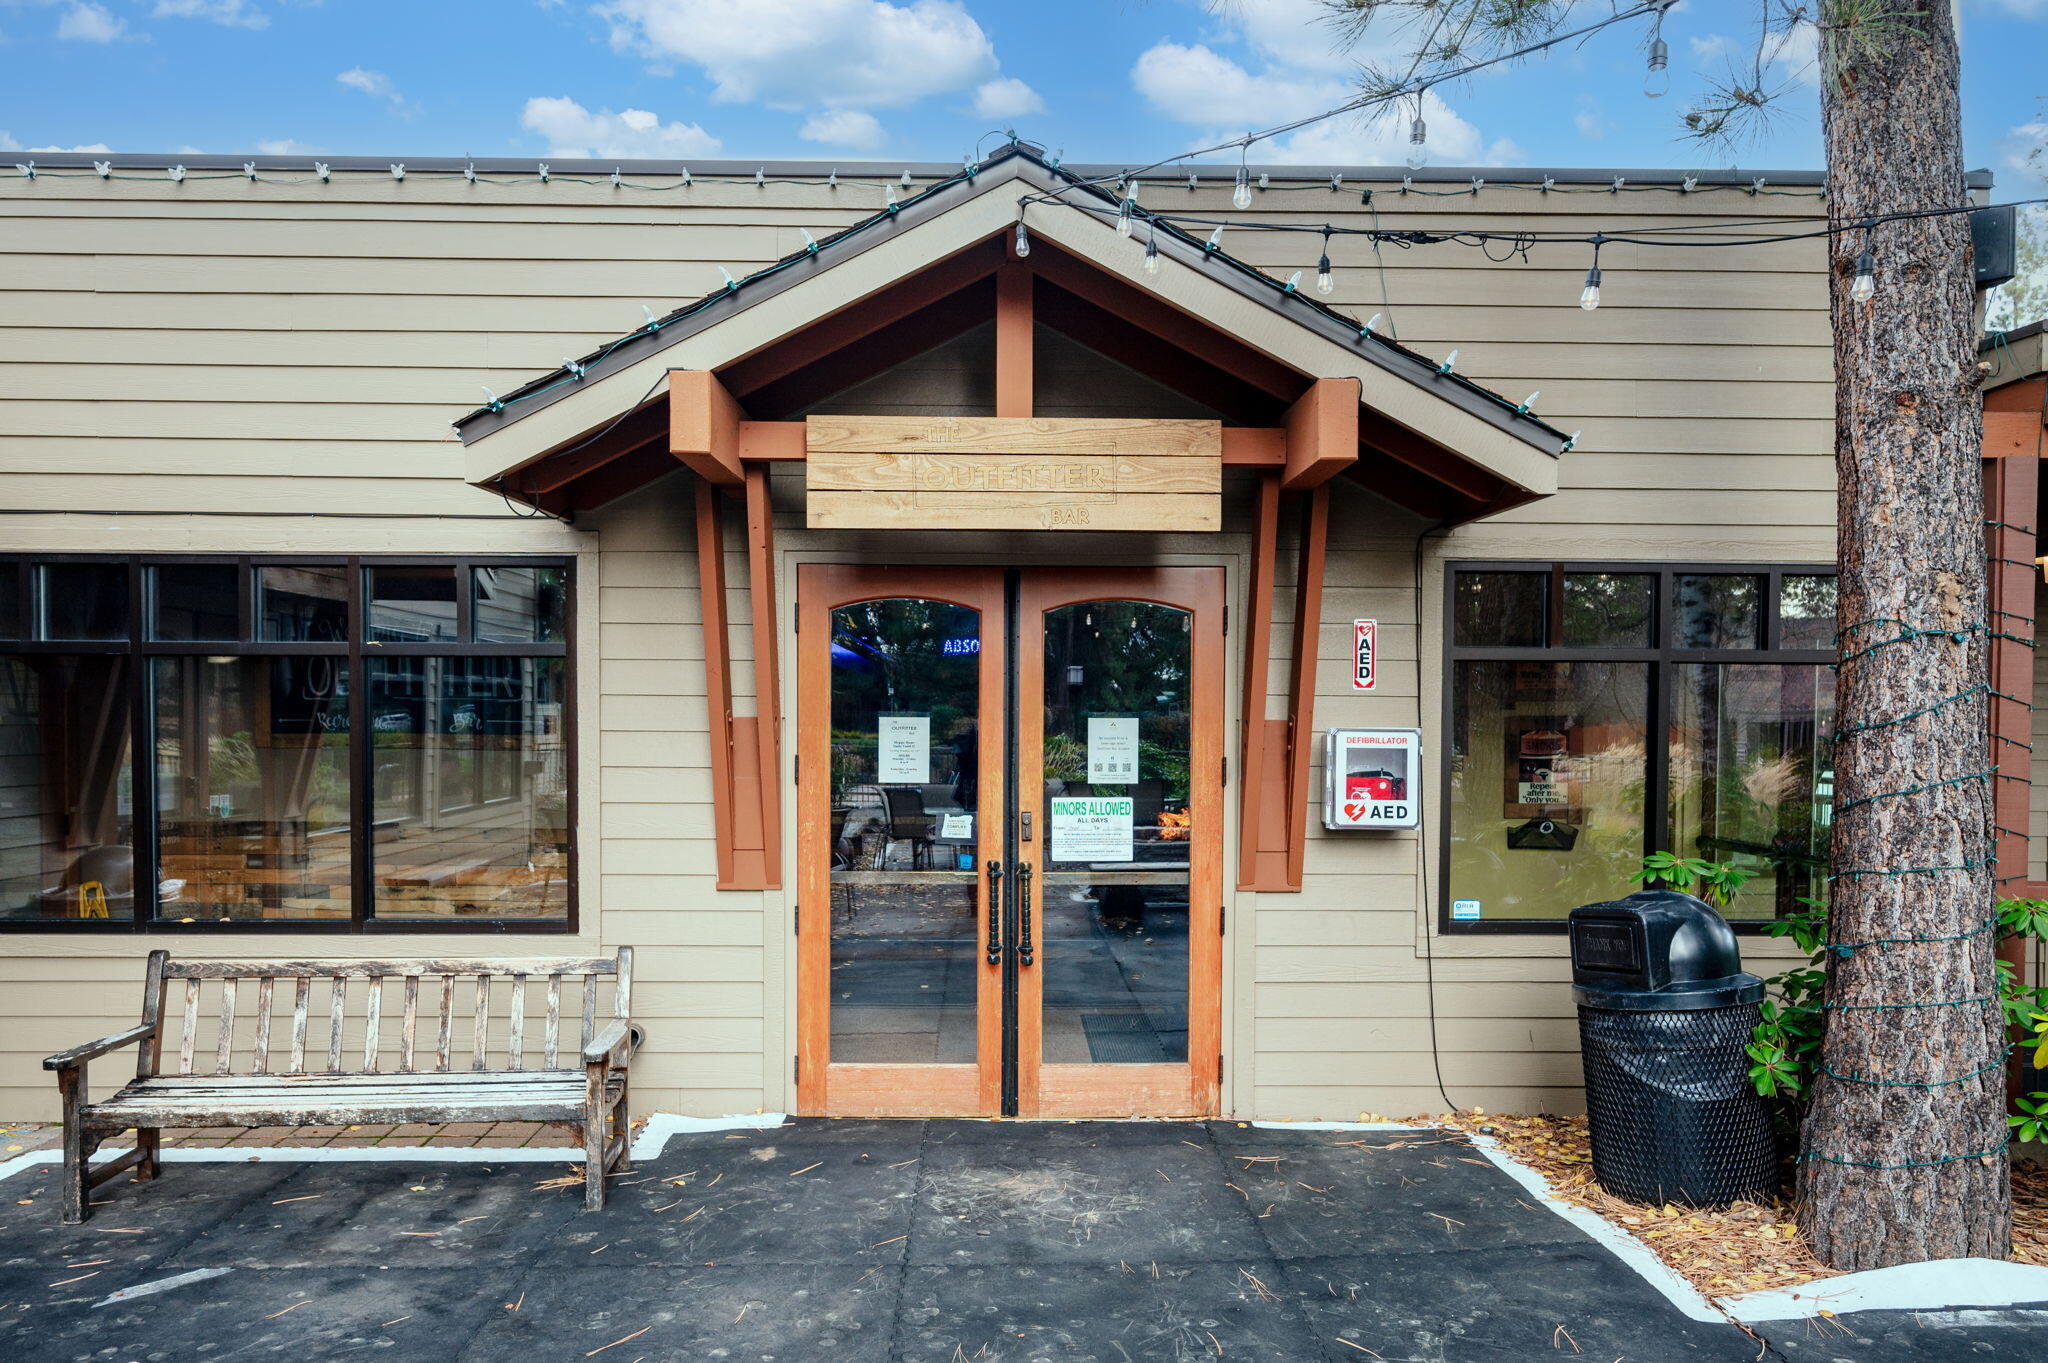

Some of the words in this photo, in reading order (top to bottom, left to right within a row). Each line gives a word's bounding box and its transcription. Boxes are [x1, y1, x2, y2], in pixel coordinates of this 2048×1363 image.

[925, 426, 961, 442] THE
[922, 464, 1105, 490] OUTFITTER
[1050, 508, 1090, 525] BAR
[943, 639, 979, 653] ABSO
[1359, 639, 1371, 679] AED
[1346, 736, 1408, 744] DEFIBRILLATOR
[1530, 783, 1557, 791] Repeat
[1053, 802, 1087, 816] MINORS
[1088, 802, 1132, 816] ALLOWED
[1370, 805, 1408, 819] AED
